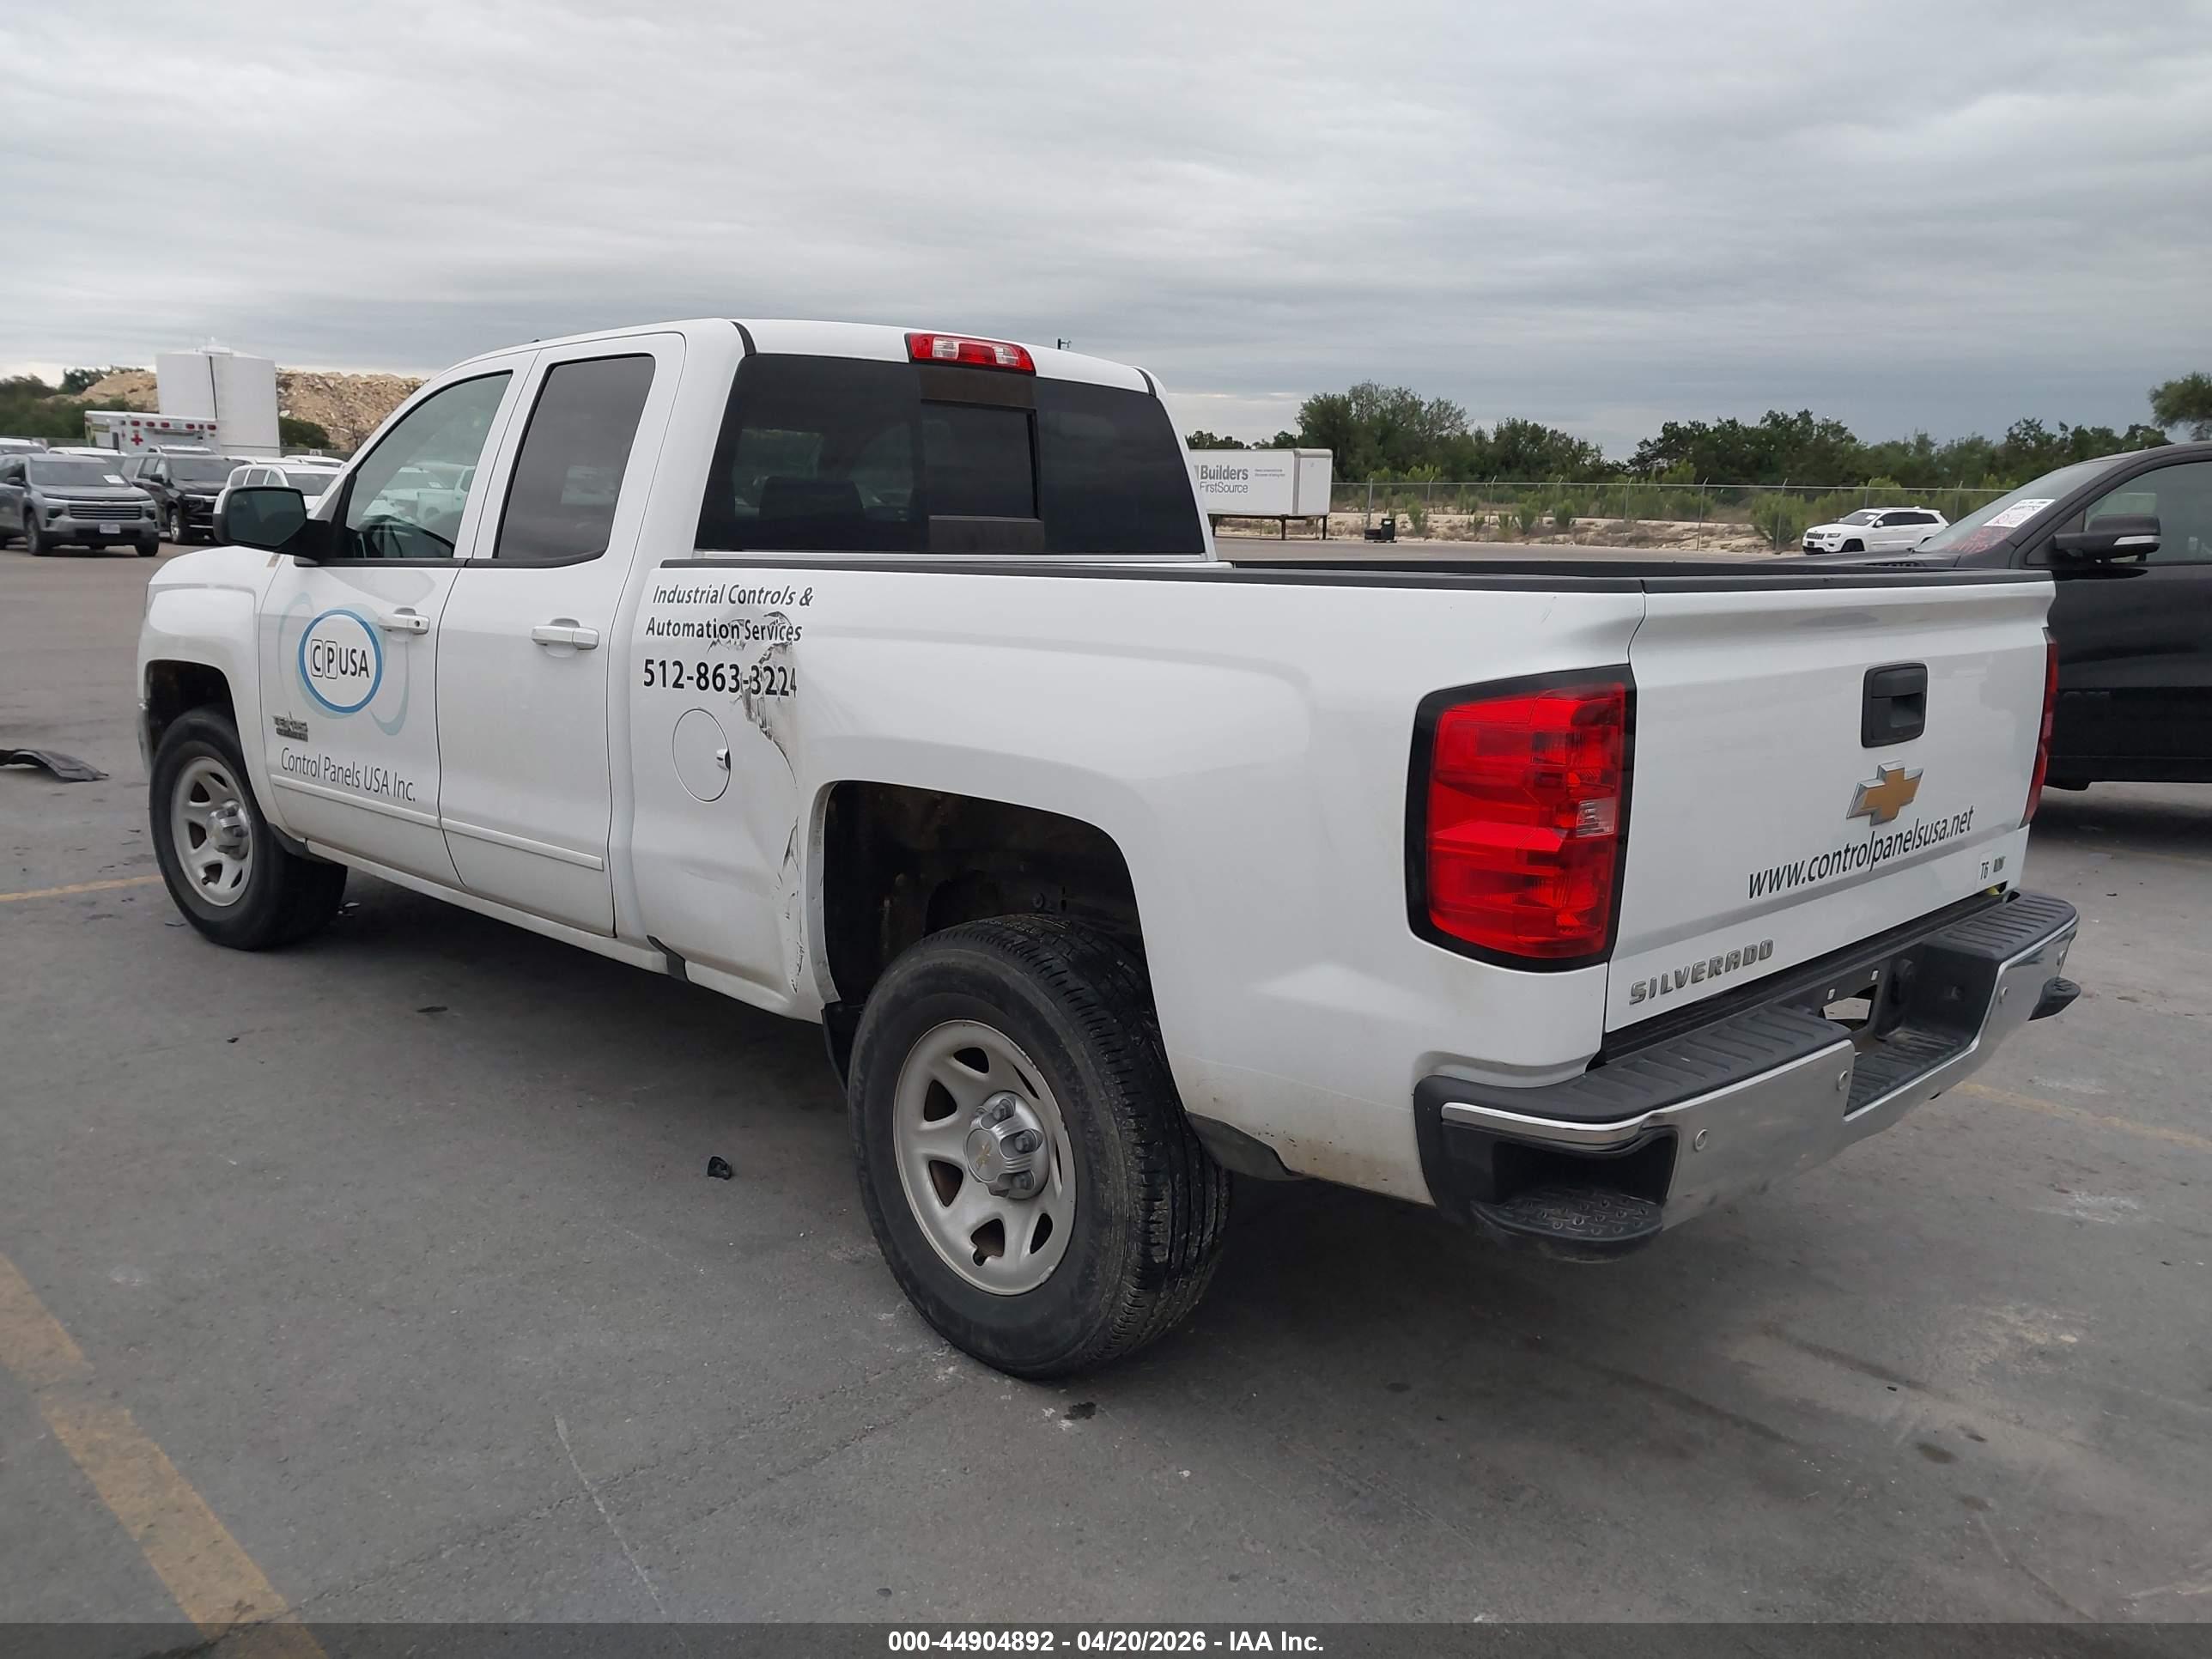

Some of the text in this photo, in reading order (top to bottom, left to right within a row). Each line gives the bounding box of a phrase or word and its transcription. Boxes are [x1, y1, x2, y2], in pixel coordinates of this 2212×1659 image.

[1200, 465, 1249, 480] Builders
[1200, 482, 1249, 494] FirstSource
[653, 584, 814, 606] Industrial Controls &
[646, 617, 803, 641] Automation Services
[643, 659, 798, 697] 512-863-3224
[281, 747, 416, 802] Control Panels USA Inc.
[1748, 805, 1974, 899] www.controlpanelsusa.net
[1629, 939, 1774, 1006] SILVERADO
